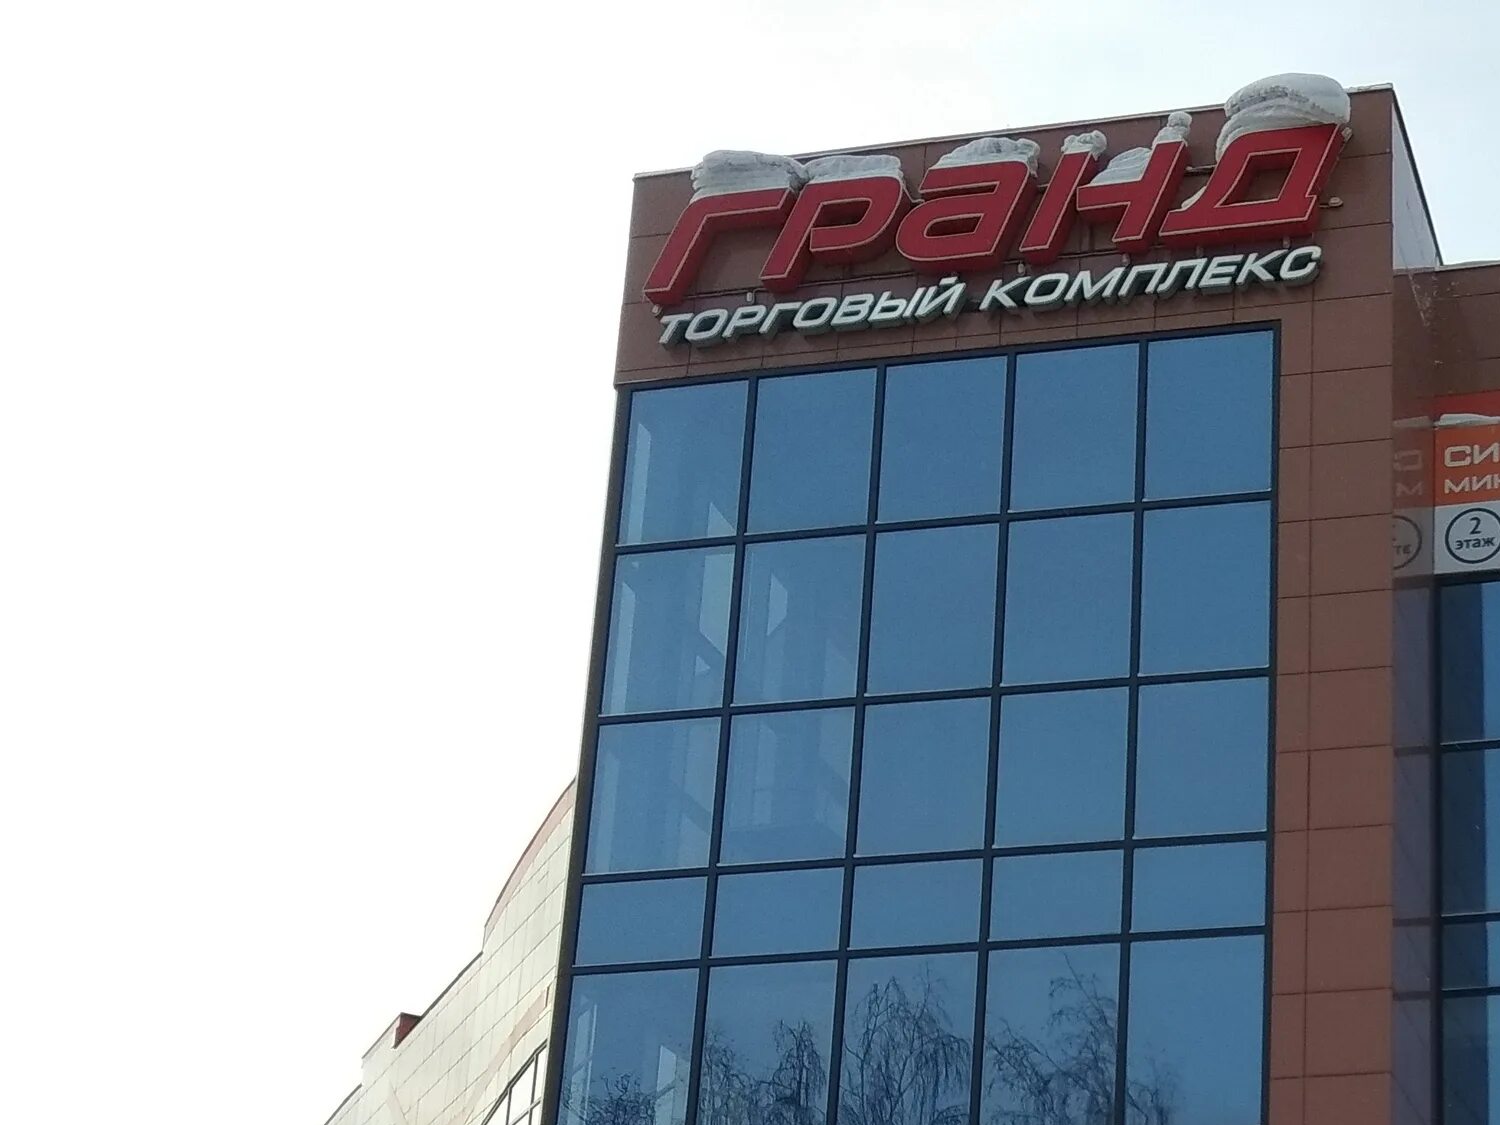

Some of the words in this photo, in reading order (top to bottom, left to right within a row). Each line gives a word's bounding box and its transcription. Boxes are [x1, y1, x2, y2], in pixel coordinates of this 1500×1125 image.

[659, 275, 966, 347] ТОРГОВЫЙ
[979, 244, 1324, 312] КОМПЛЕКС
[1469, 517, 1482, 535] 2
[1455, 535, 1496, 550] этаж
